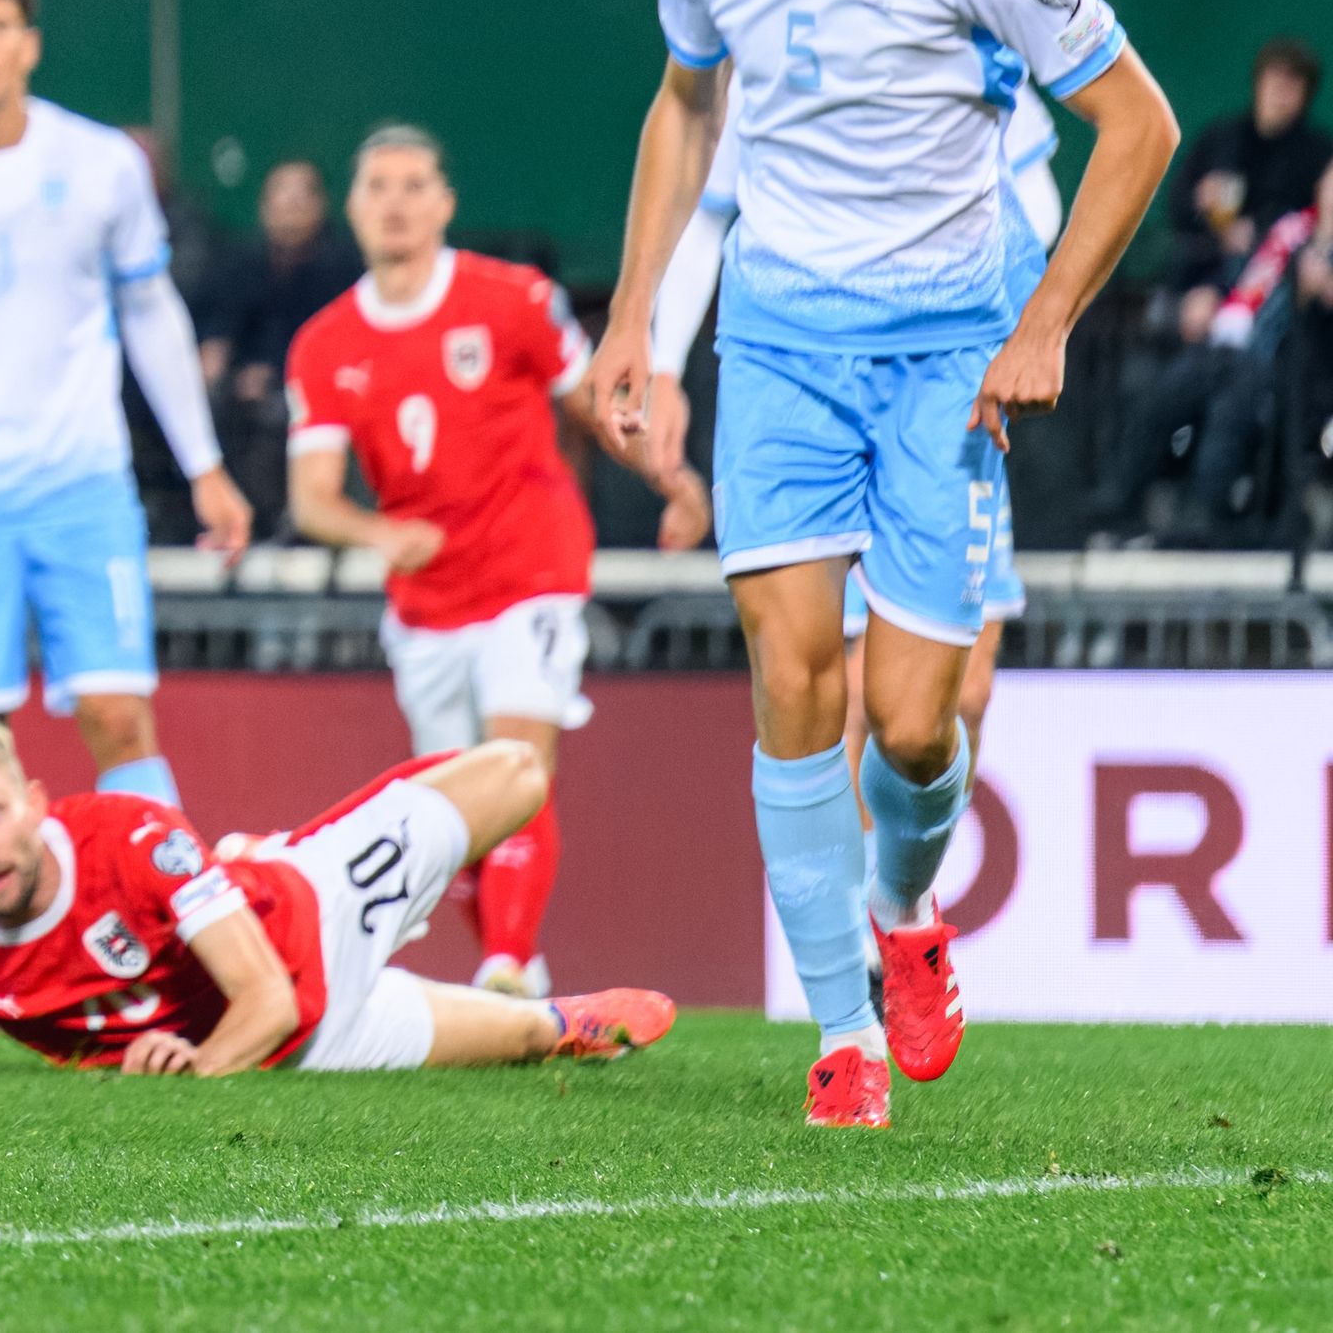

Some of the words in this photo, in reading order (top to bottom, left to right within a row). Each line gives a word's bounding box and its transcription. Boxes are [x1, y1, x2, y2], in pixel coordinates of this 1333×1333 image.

[786, 11, 821, 91] 5
[397, 394, 438, 473] 9
[965, 481, 993, 563] 5
[347, 837, 409, 934] 20
